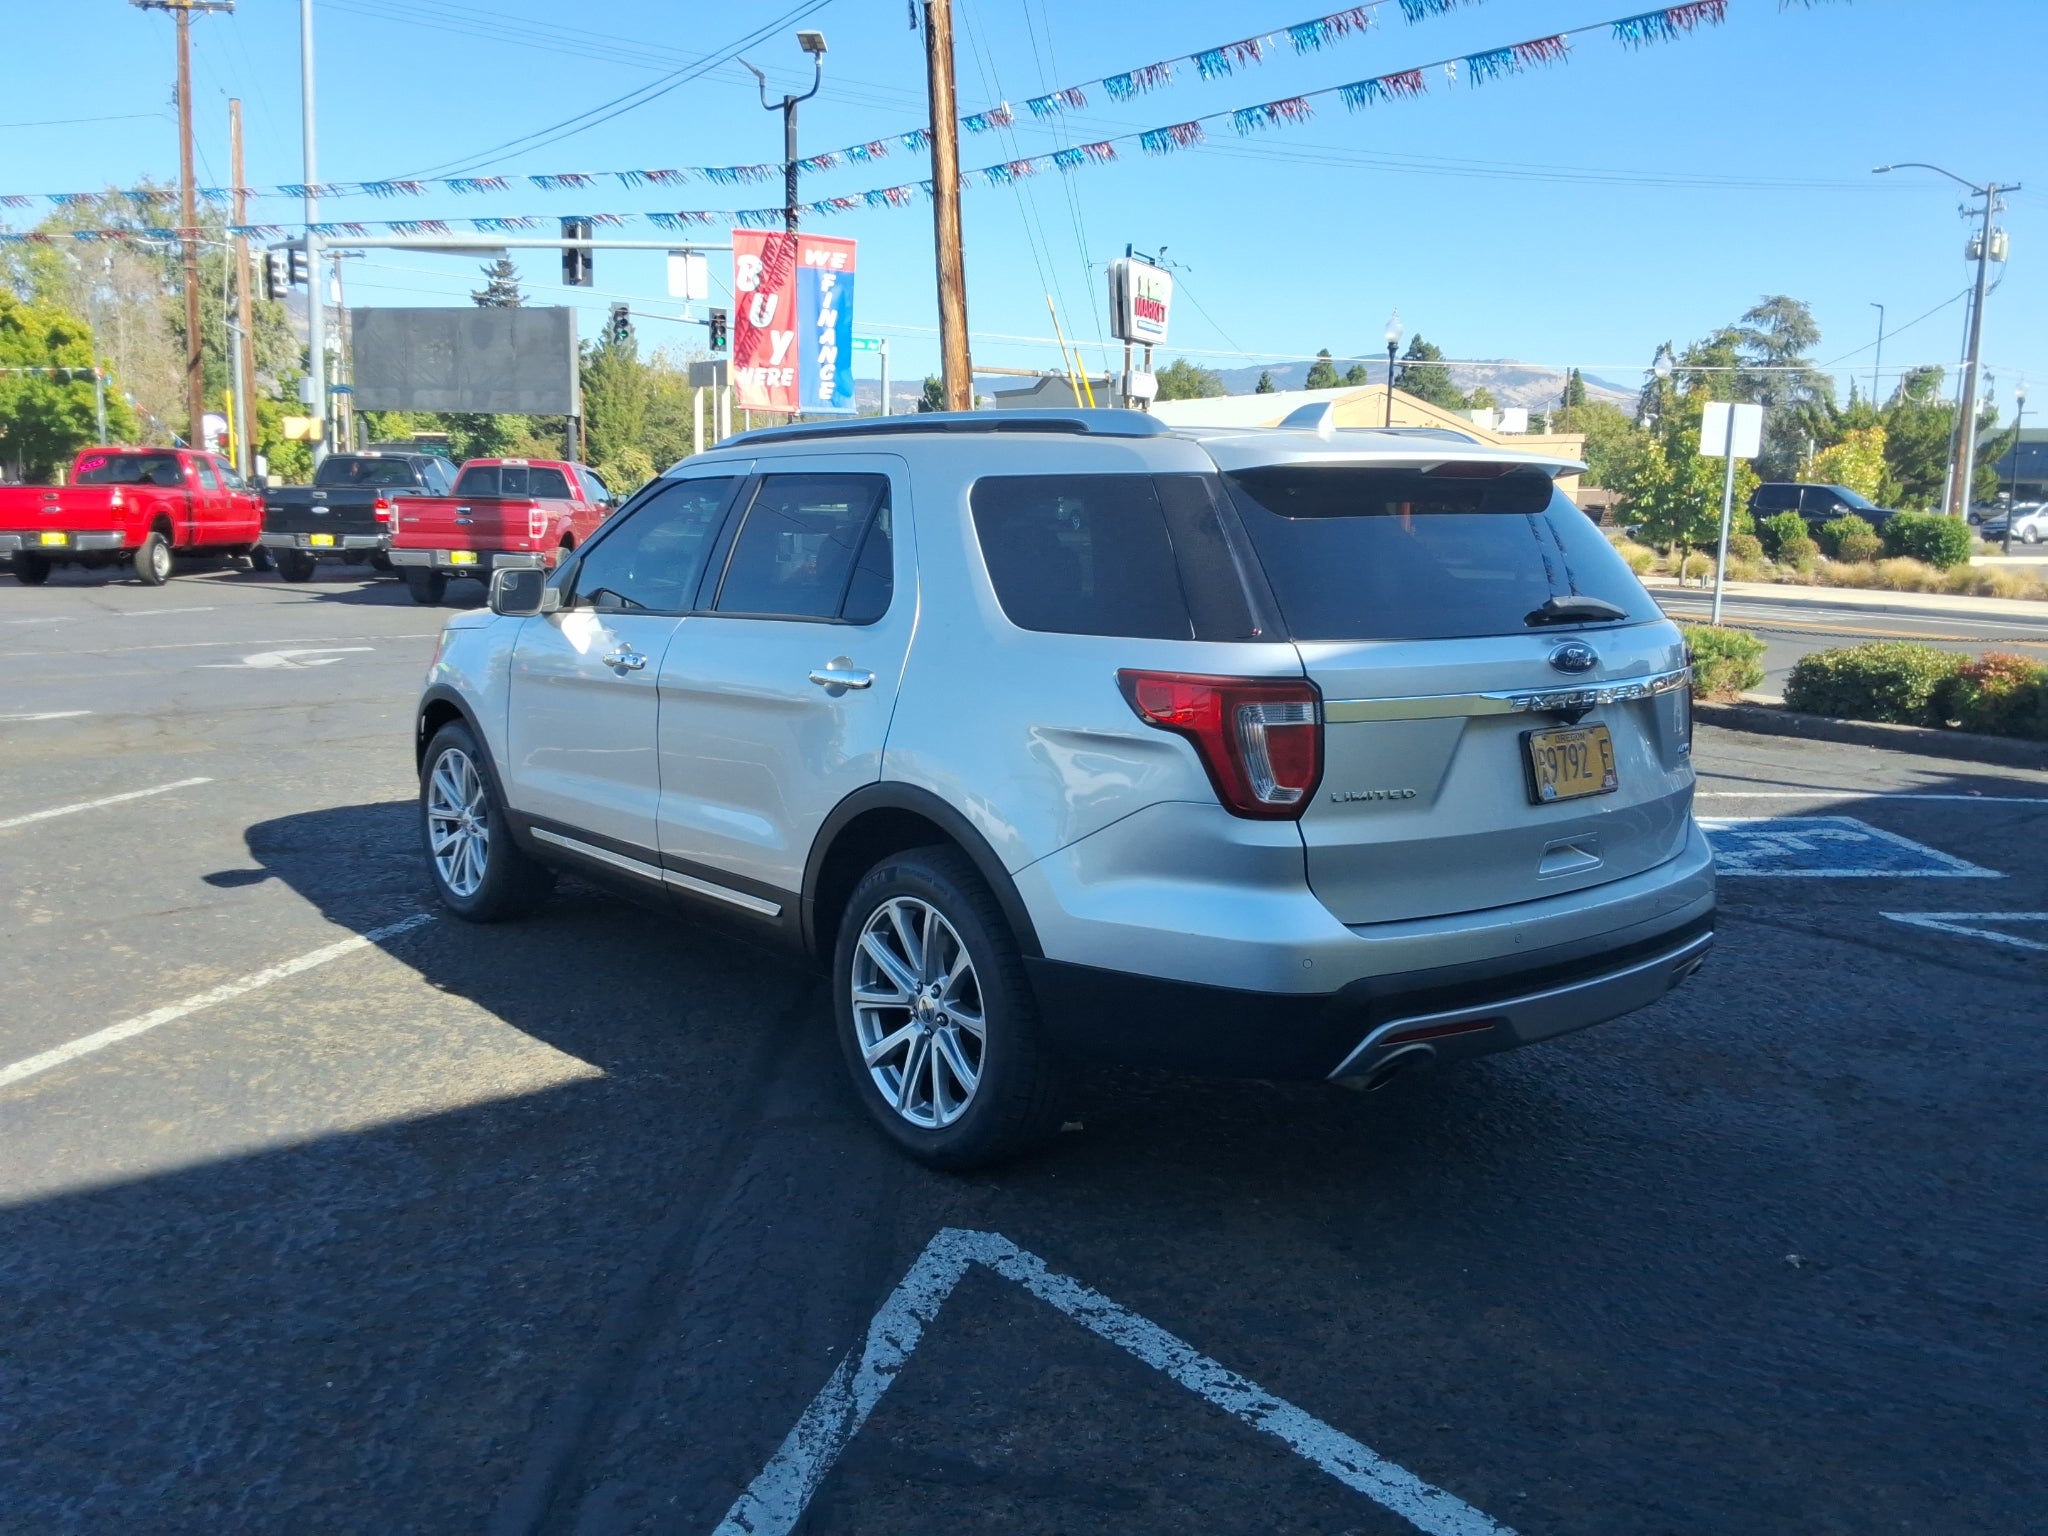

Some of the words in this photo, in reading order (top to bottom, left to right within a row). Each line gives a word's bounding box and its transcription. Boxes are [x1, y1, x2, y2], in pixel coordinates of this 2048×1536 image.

[805, 249, 847, 268] WE
[736, 254, 794, 365] BUY
[1134, 297, 1166, 323] MARKET
[817, 273, 837, 400] FINANCE
[739, 367, 794, 388] HERE
[1555, 732, 1586, 744] OREGON
[1331, 787, 1418, 803] LIMITED
